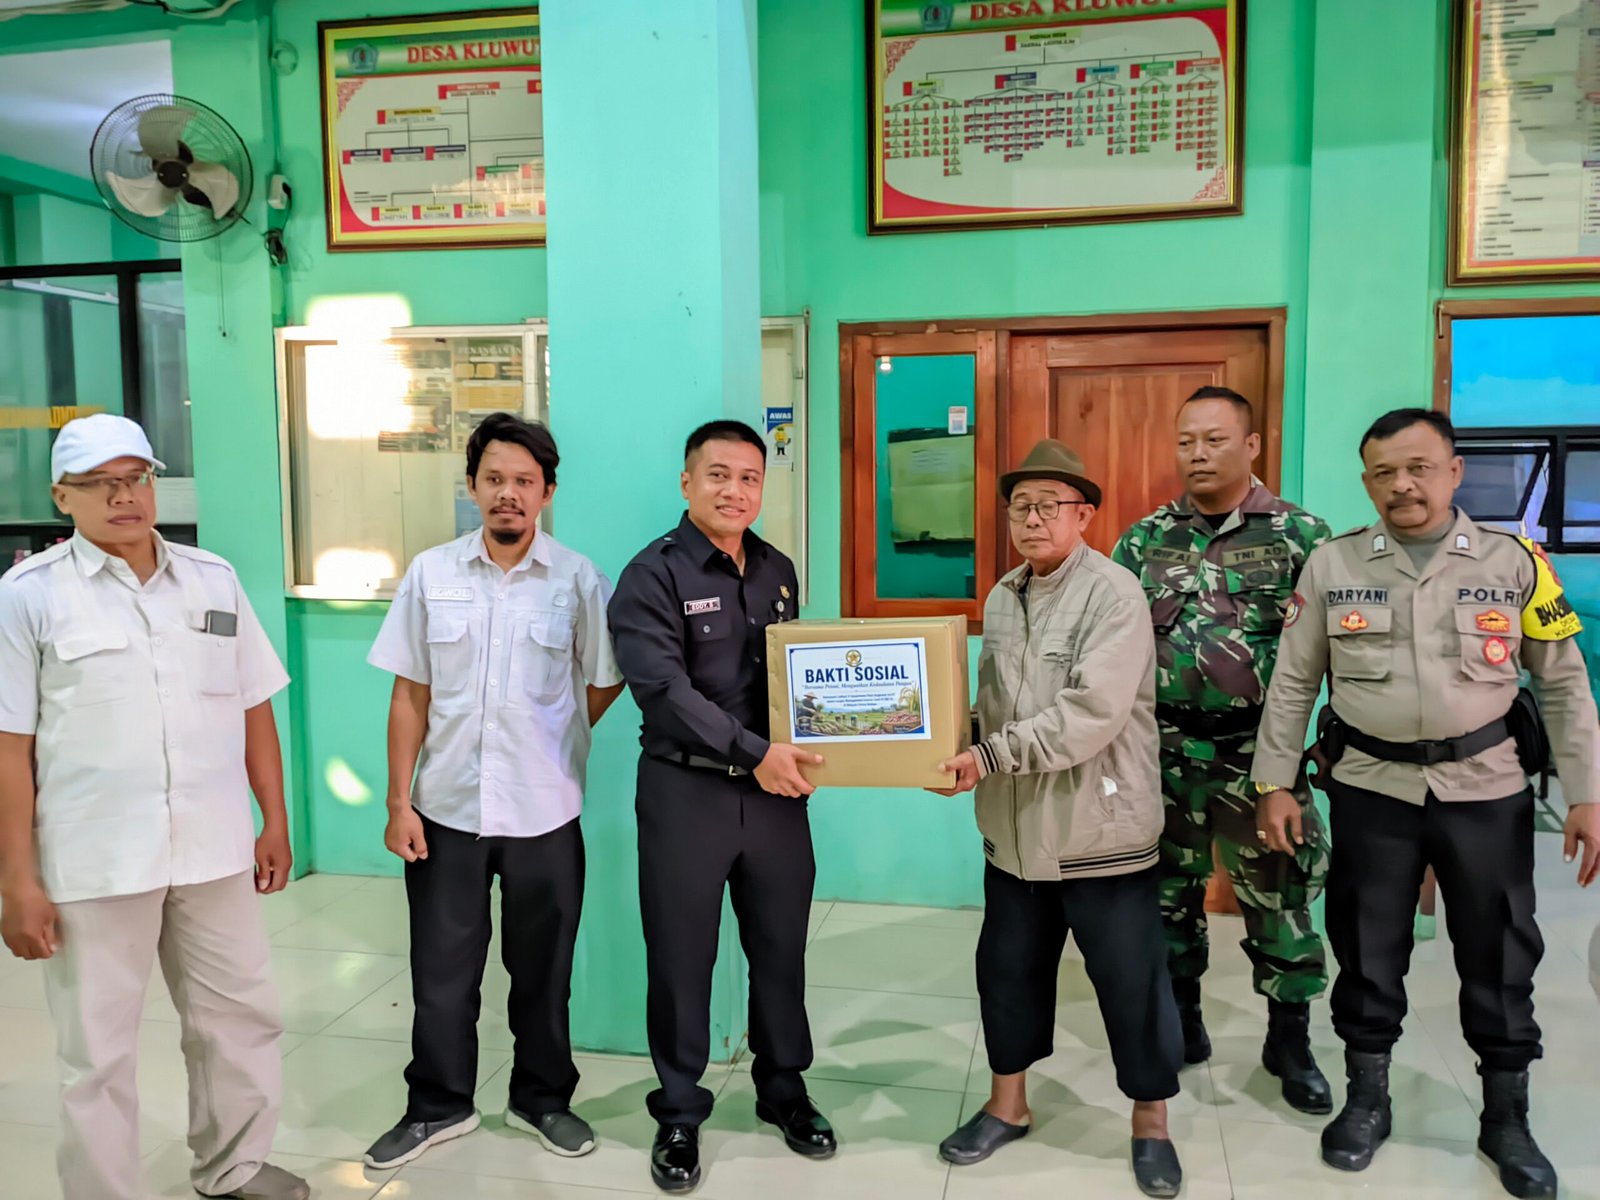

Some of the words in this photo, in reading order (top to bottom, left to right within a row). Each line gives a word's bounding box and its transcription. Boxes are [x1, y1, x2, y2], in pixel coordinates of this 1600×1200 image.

[970, 0, 1044, 21] DESA
[407, 45, 458, 64] DESA
[769, 412, 792, 420] AWAS
[1152, 549, 1191, 563] RIFAI
[1233, 552, 1255, 562] TNI
[1264, 547, 1282, 556] AD
[1328, 589, 1388, 603] DARYANI
[1458, 588, 1522, 605] POLRI
[805, 668, 849, 683] BAKTI
[854, 665, 909, 681] SOSIAL
